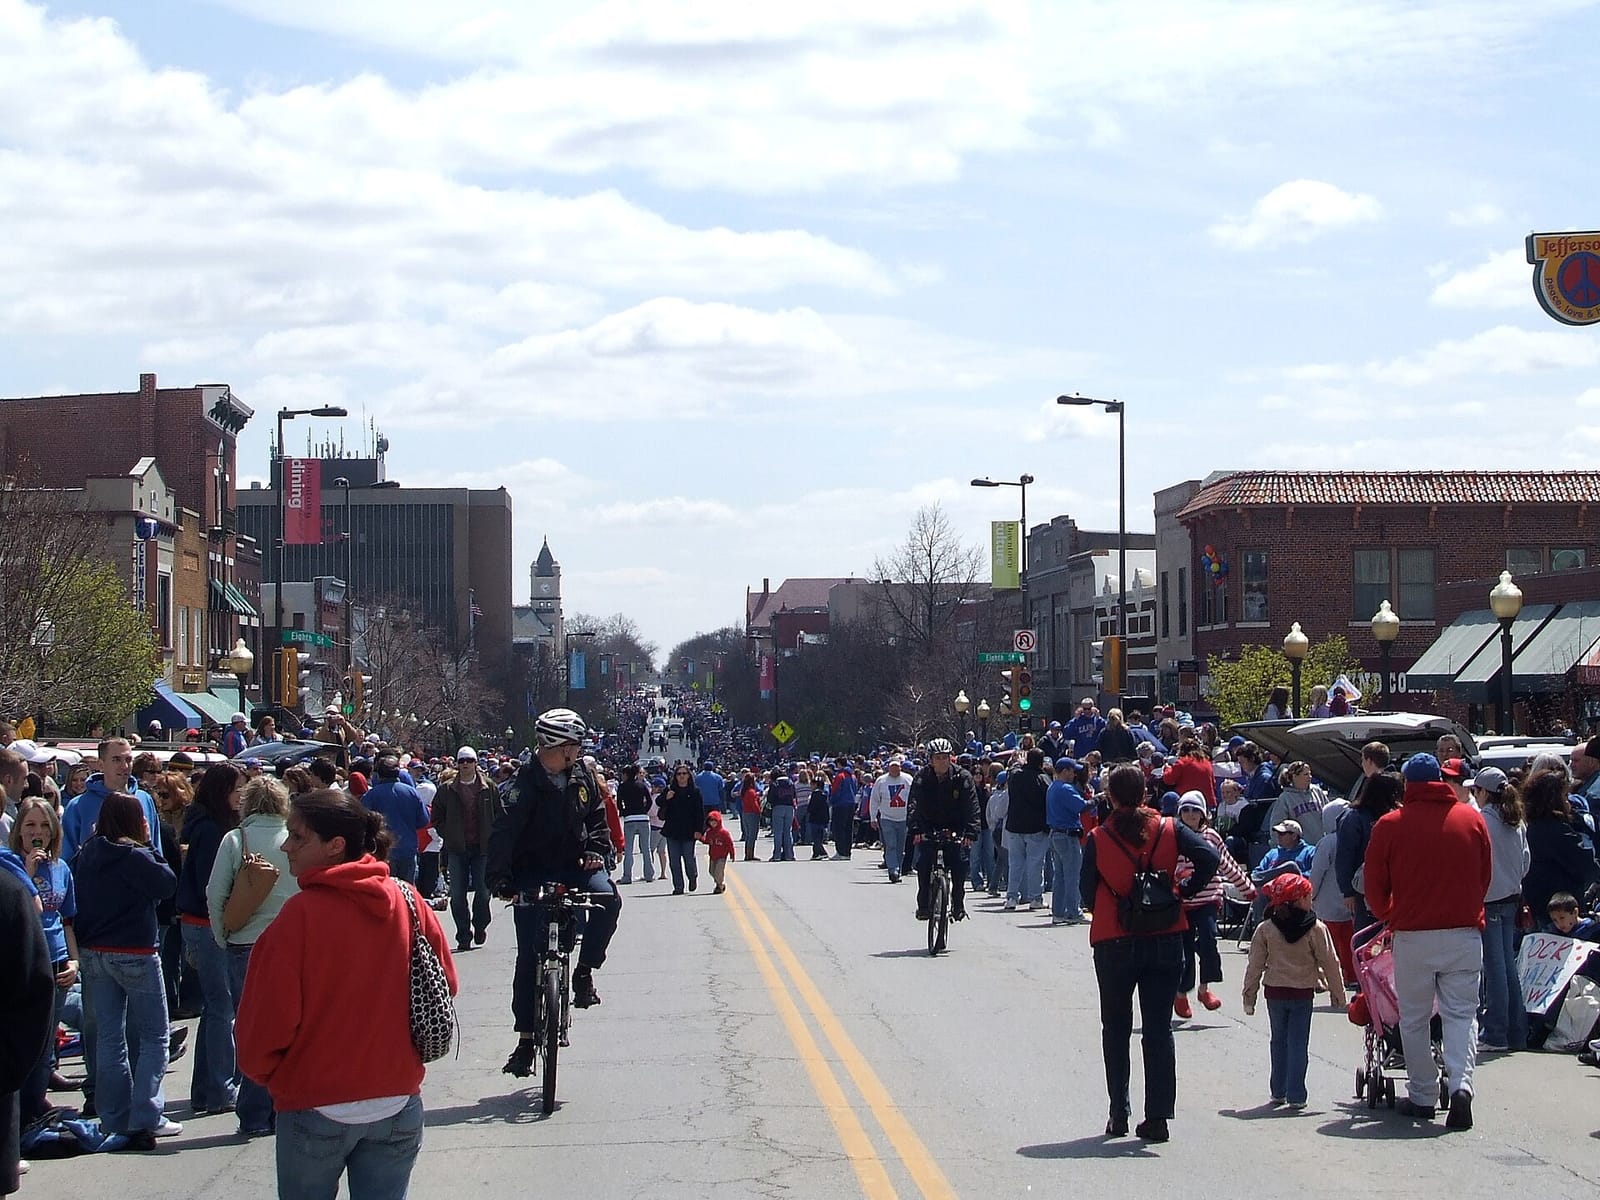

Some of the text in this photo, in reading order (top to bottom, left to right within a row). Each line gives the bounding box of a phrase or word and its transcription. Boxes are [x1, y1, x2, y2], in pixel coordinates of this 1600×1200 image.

[288, 459, 306, 509] dining
[995, 522, 1008, 568] culture
[138, 543, 146, 613] CENTRA
[291, 631, 324, 645] Eighth St
[985, 654, 1004, 662] Eighth
[888, 784, 906, 807] K
